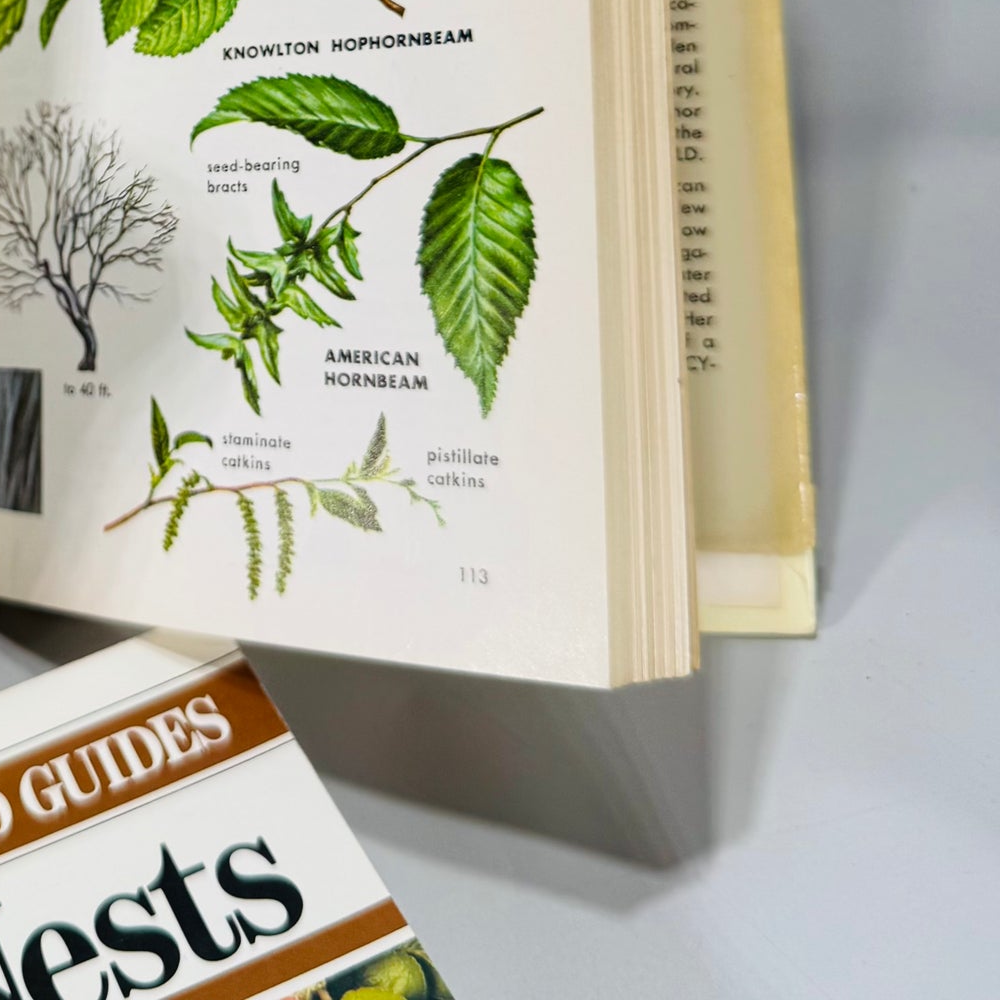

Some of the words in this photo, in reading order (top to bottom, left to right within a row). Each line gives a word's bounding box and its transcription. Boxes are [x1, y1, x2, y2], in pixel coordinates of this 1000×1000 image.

[222, 40, 320, 61] KNOWLTON
[331, 28, 474, 53] HOPHORNBEAM
[207, 156, 300, 174] seed-bearing
[207, 181, 248, 195] bracts
[324, 348, 420, 367] AMERICAN
[323, 371, 429, 391] HORNBEAM
[222, 433, 292, 450] staminate
[221, 455, 271, 471] catkins
[427, 448, 500, 467] pistillate
[427, 472, 485, 489] catkins
[459, 567, 489, 585] 113
[18, 693, 233, 824] GUIDES
